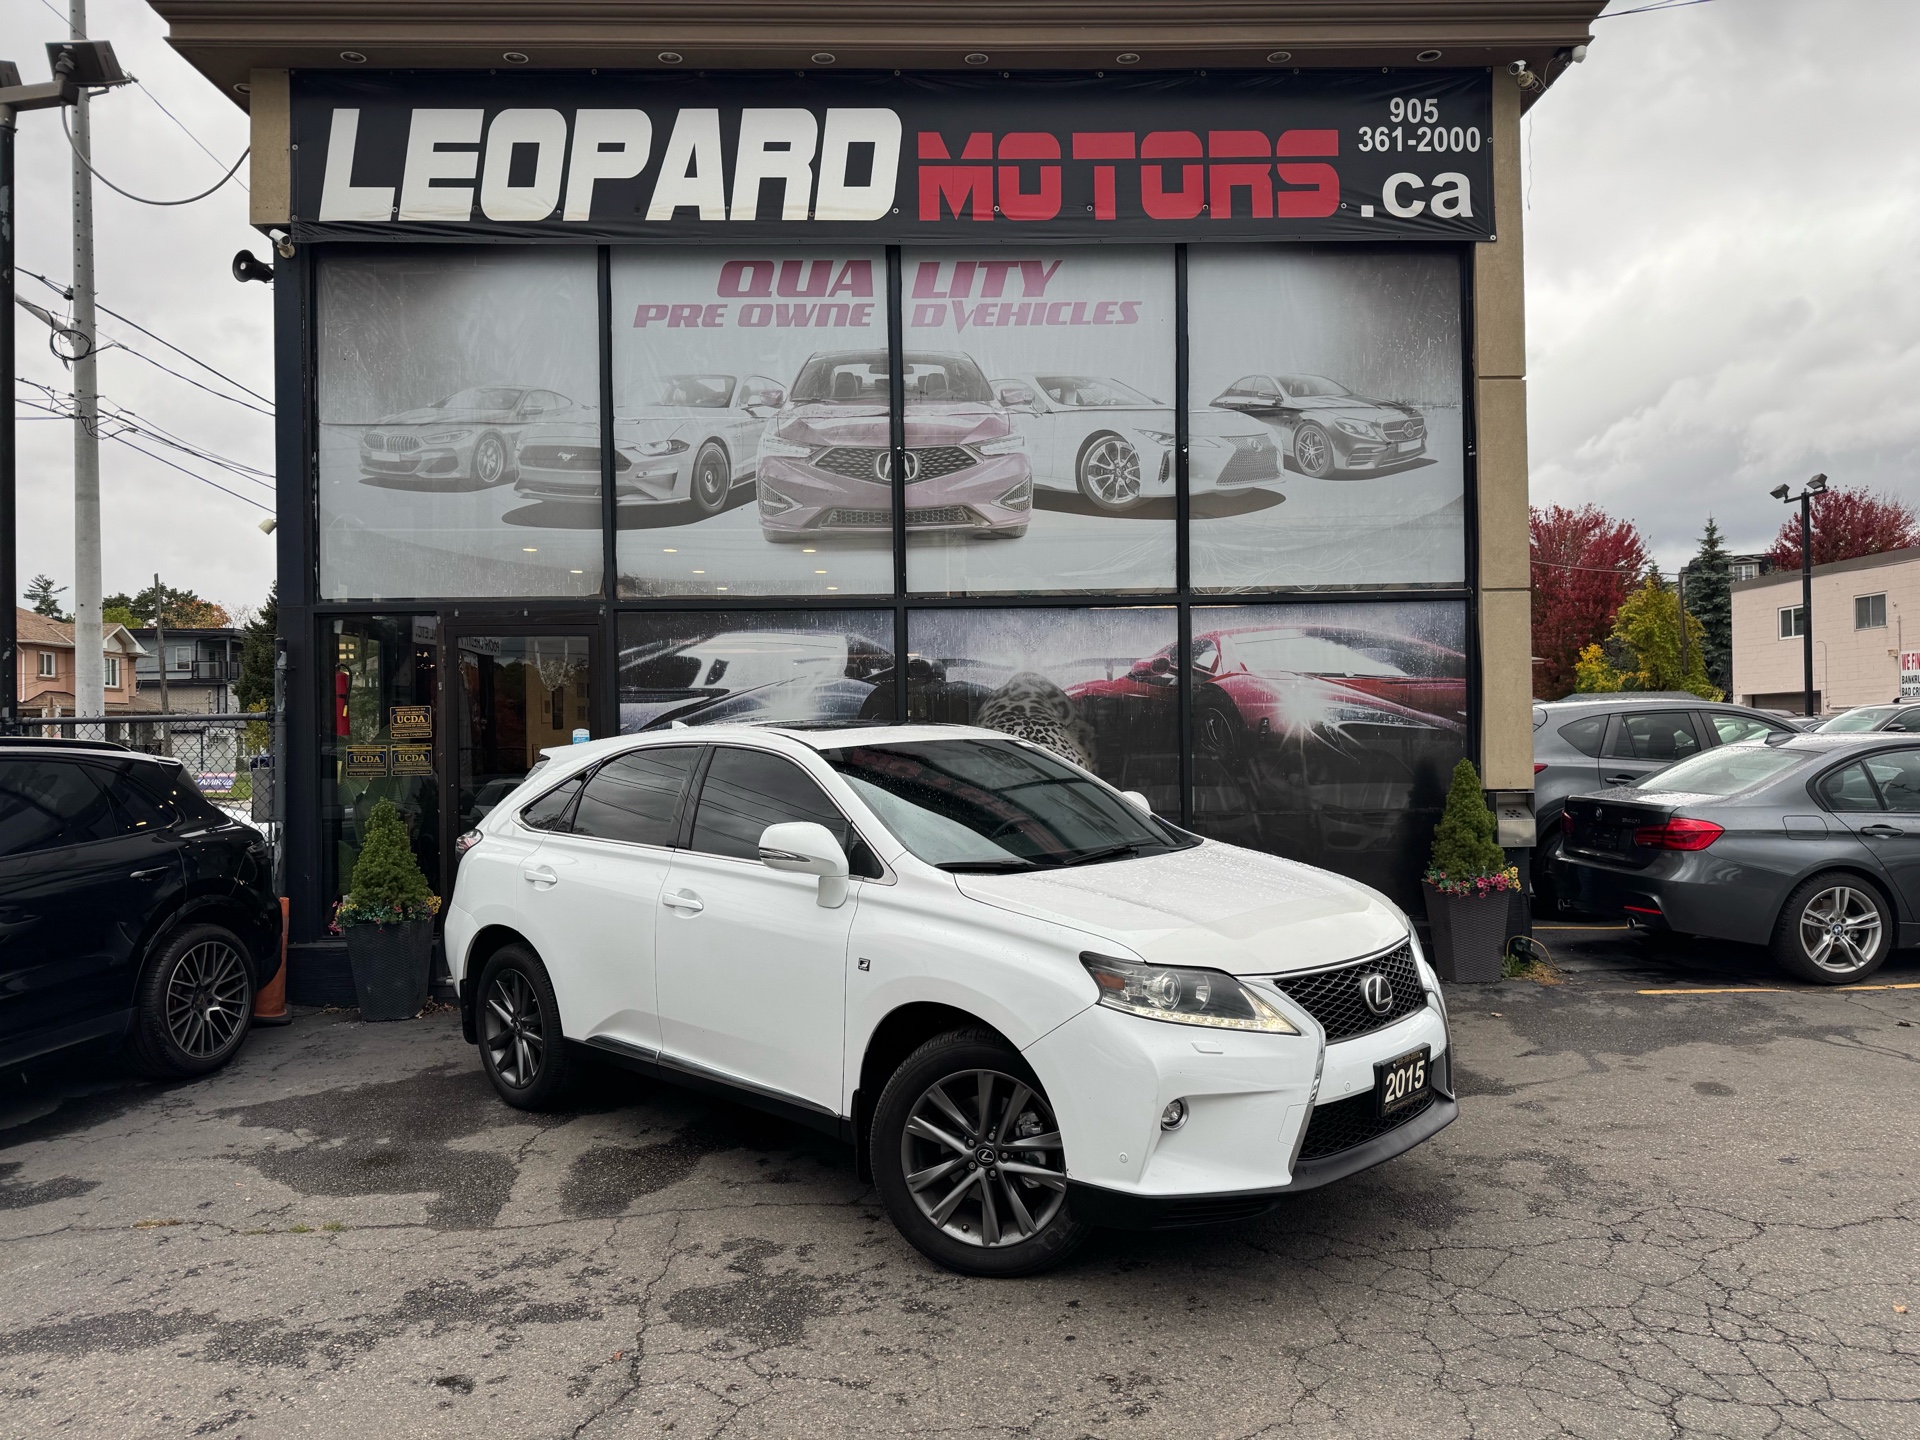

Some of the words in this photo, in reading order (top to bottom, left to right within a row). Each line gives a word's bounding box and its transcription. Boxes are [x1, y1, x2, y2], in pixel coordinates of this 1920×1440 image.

[1389, 97, 1439, 124] 905
[1358, 126, 1480, 152] 361-2000
[318, 108, 902, 222] LEOPARD
[918, 130, 1340, 222] MOTORS
[1361, 172, 1474, 218] .ca
[633, 304, 728, 328] PRE
[397, 715, 426, 724] UCDA
[353, 755, 381, 763] UCDA
[398, 754, 426, 762] UCDA
[1384, 1060, 1425, 1104] 2015
